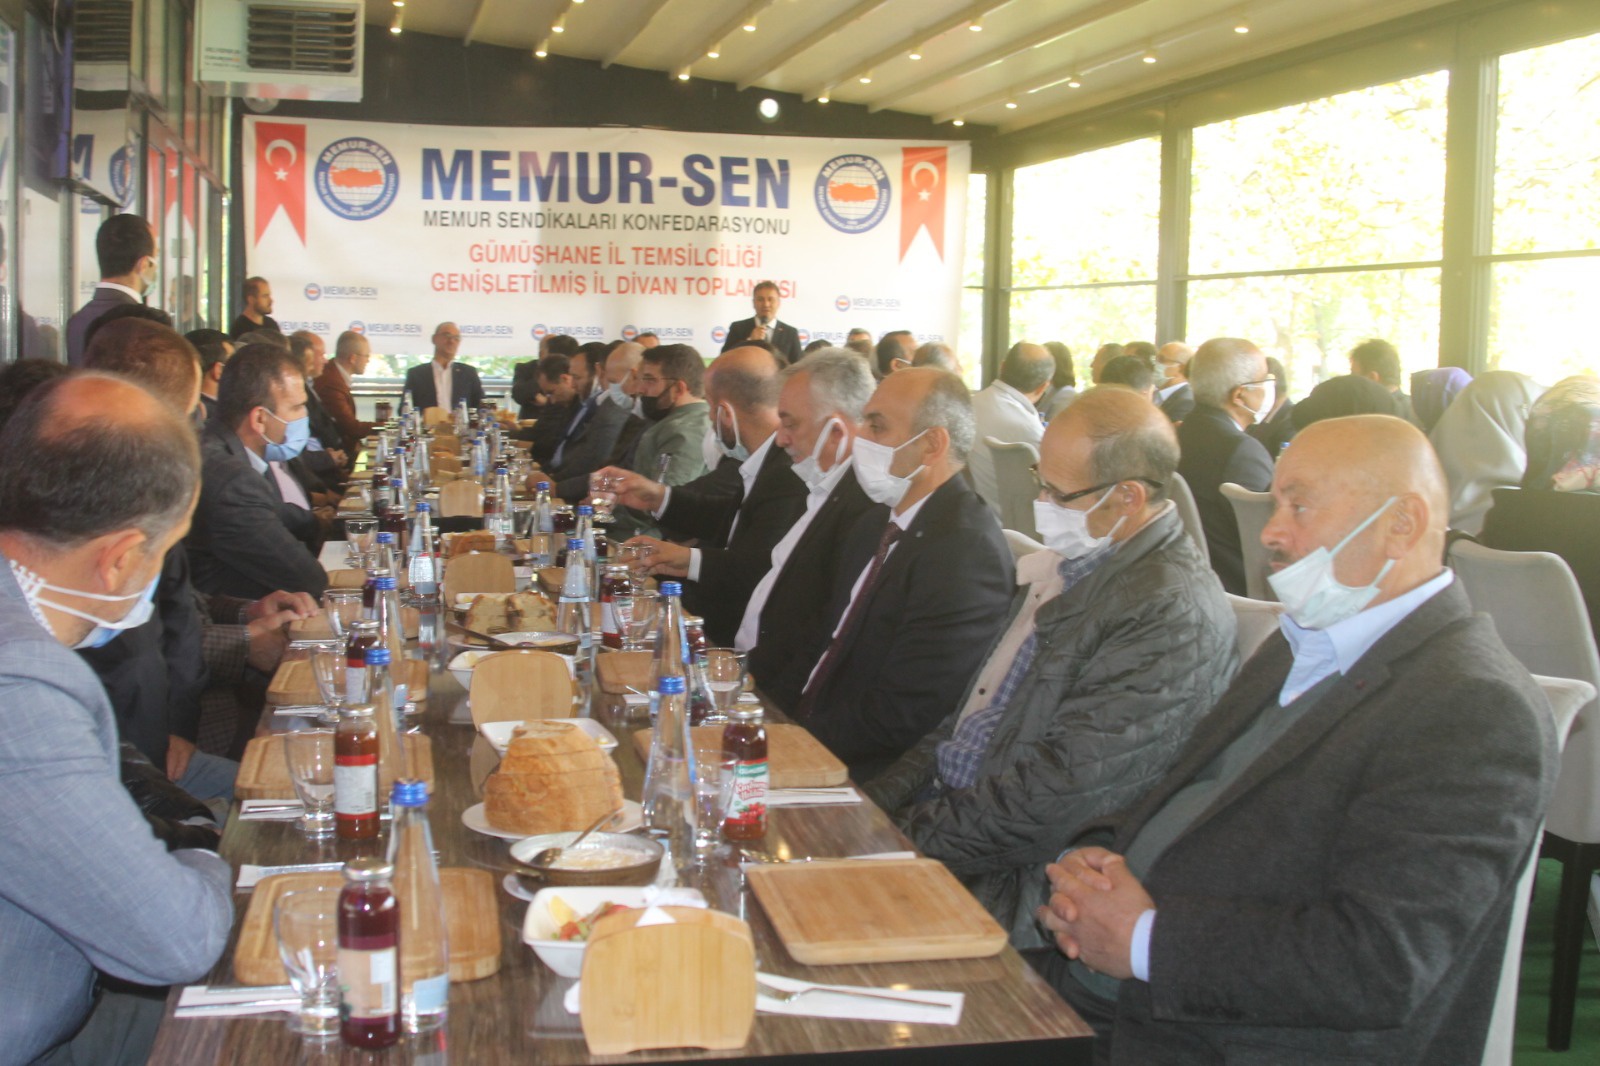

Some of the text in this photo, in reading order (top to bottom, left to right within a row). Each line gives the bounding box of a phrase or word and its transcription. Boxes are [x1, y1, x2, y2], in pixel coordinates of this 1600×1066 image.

[321, 140, 392, 165] MEMUR-SEN
[421, 148, 790, 209] MEMUR-SEN
[423, 209, 790, 235] MEMUR SENDİKALARI KONFEDARASYONU
[469, 239, 762, 268] GÜMÜŞHANE İL TEMSİLCİLİĞİ
[323, 286, 378, 296] MEMUR-SEN
[431, 269, 796, 298] GENİŞLETİLMİŞ İL DİVAN TOPLANSI
[852, 298, 901, 307] MEMUR-SEN
[367, 323, 422, 333] MEMUR-SEN
[459, 325, 513, 334] MEMUR-SEN
